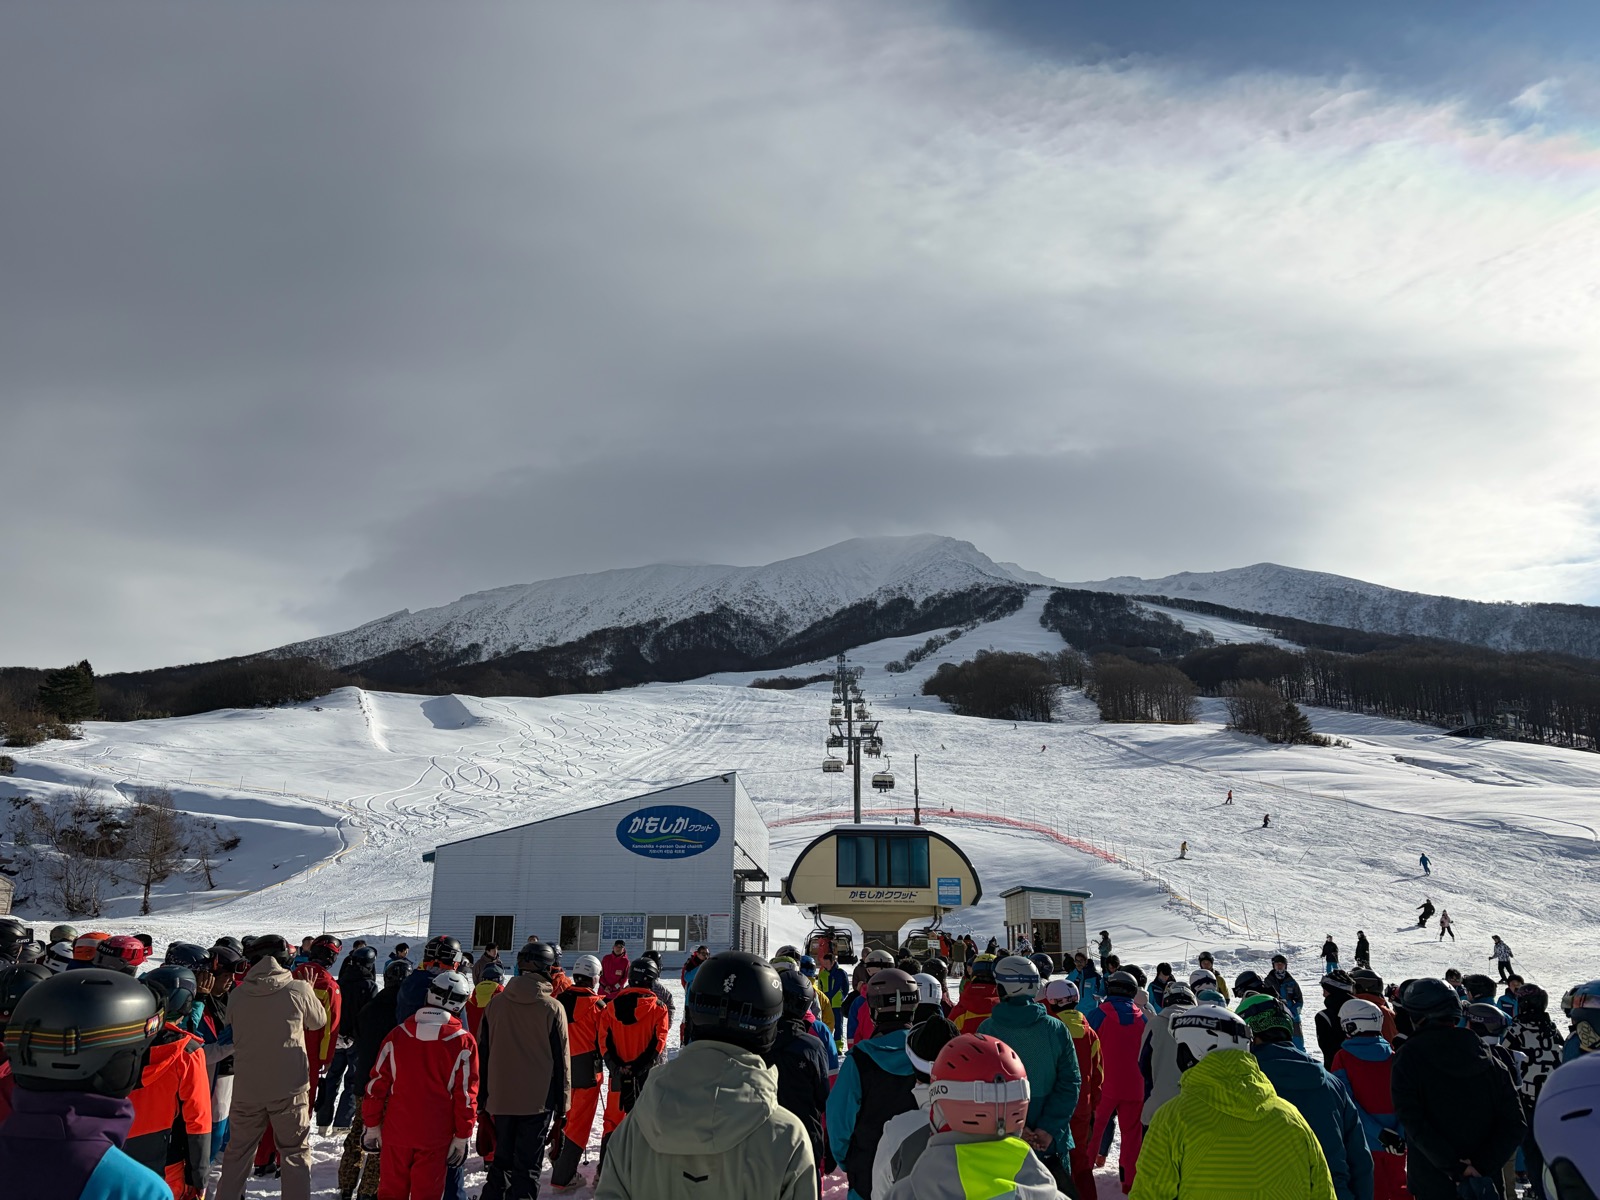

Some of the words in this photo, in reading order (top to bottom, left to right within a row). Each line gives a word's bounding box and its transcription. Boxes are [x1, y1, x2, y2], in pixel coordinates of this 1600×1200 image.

[849, 890, 918, 900] かもしかクワッド
[1174, 1017, 1218, 1028] SWANS
